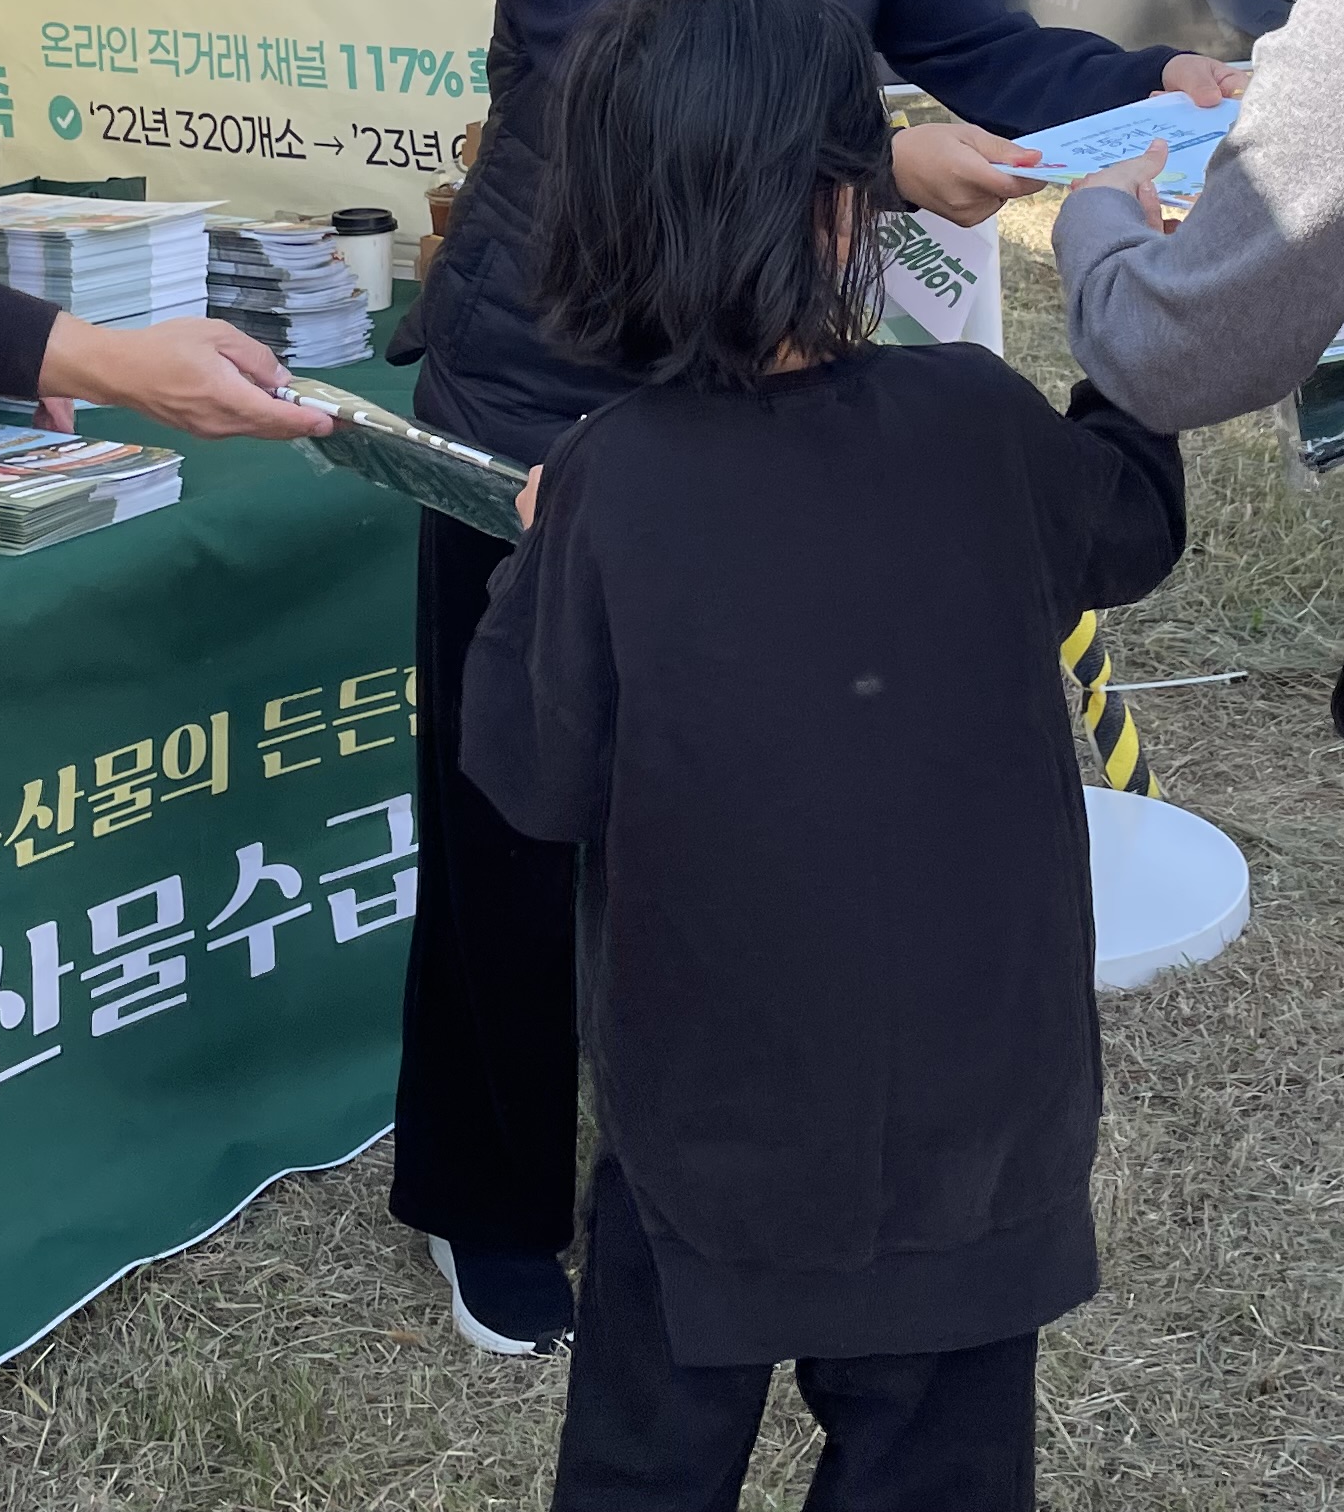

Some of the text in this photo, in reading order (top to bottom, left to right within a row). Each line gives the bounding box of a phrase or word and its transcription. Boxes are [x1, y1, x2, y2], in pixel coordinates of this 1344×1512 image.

[40, 21, 140, 74] 온라인
[146, 27, 251, 84] 직거래
[257, 36, 329, 89] 채널
[339, 44, 464, 98] 117%
[175, 109, 308, 161] 320개소
